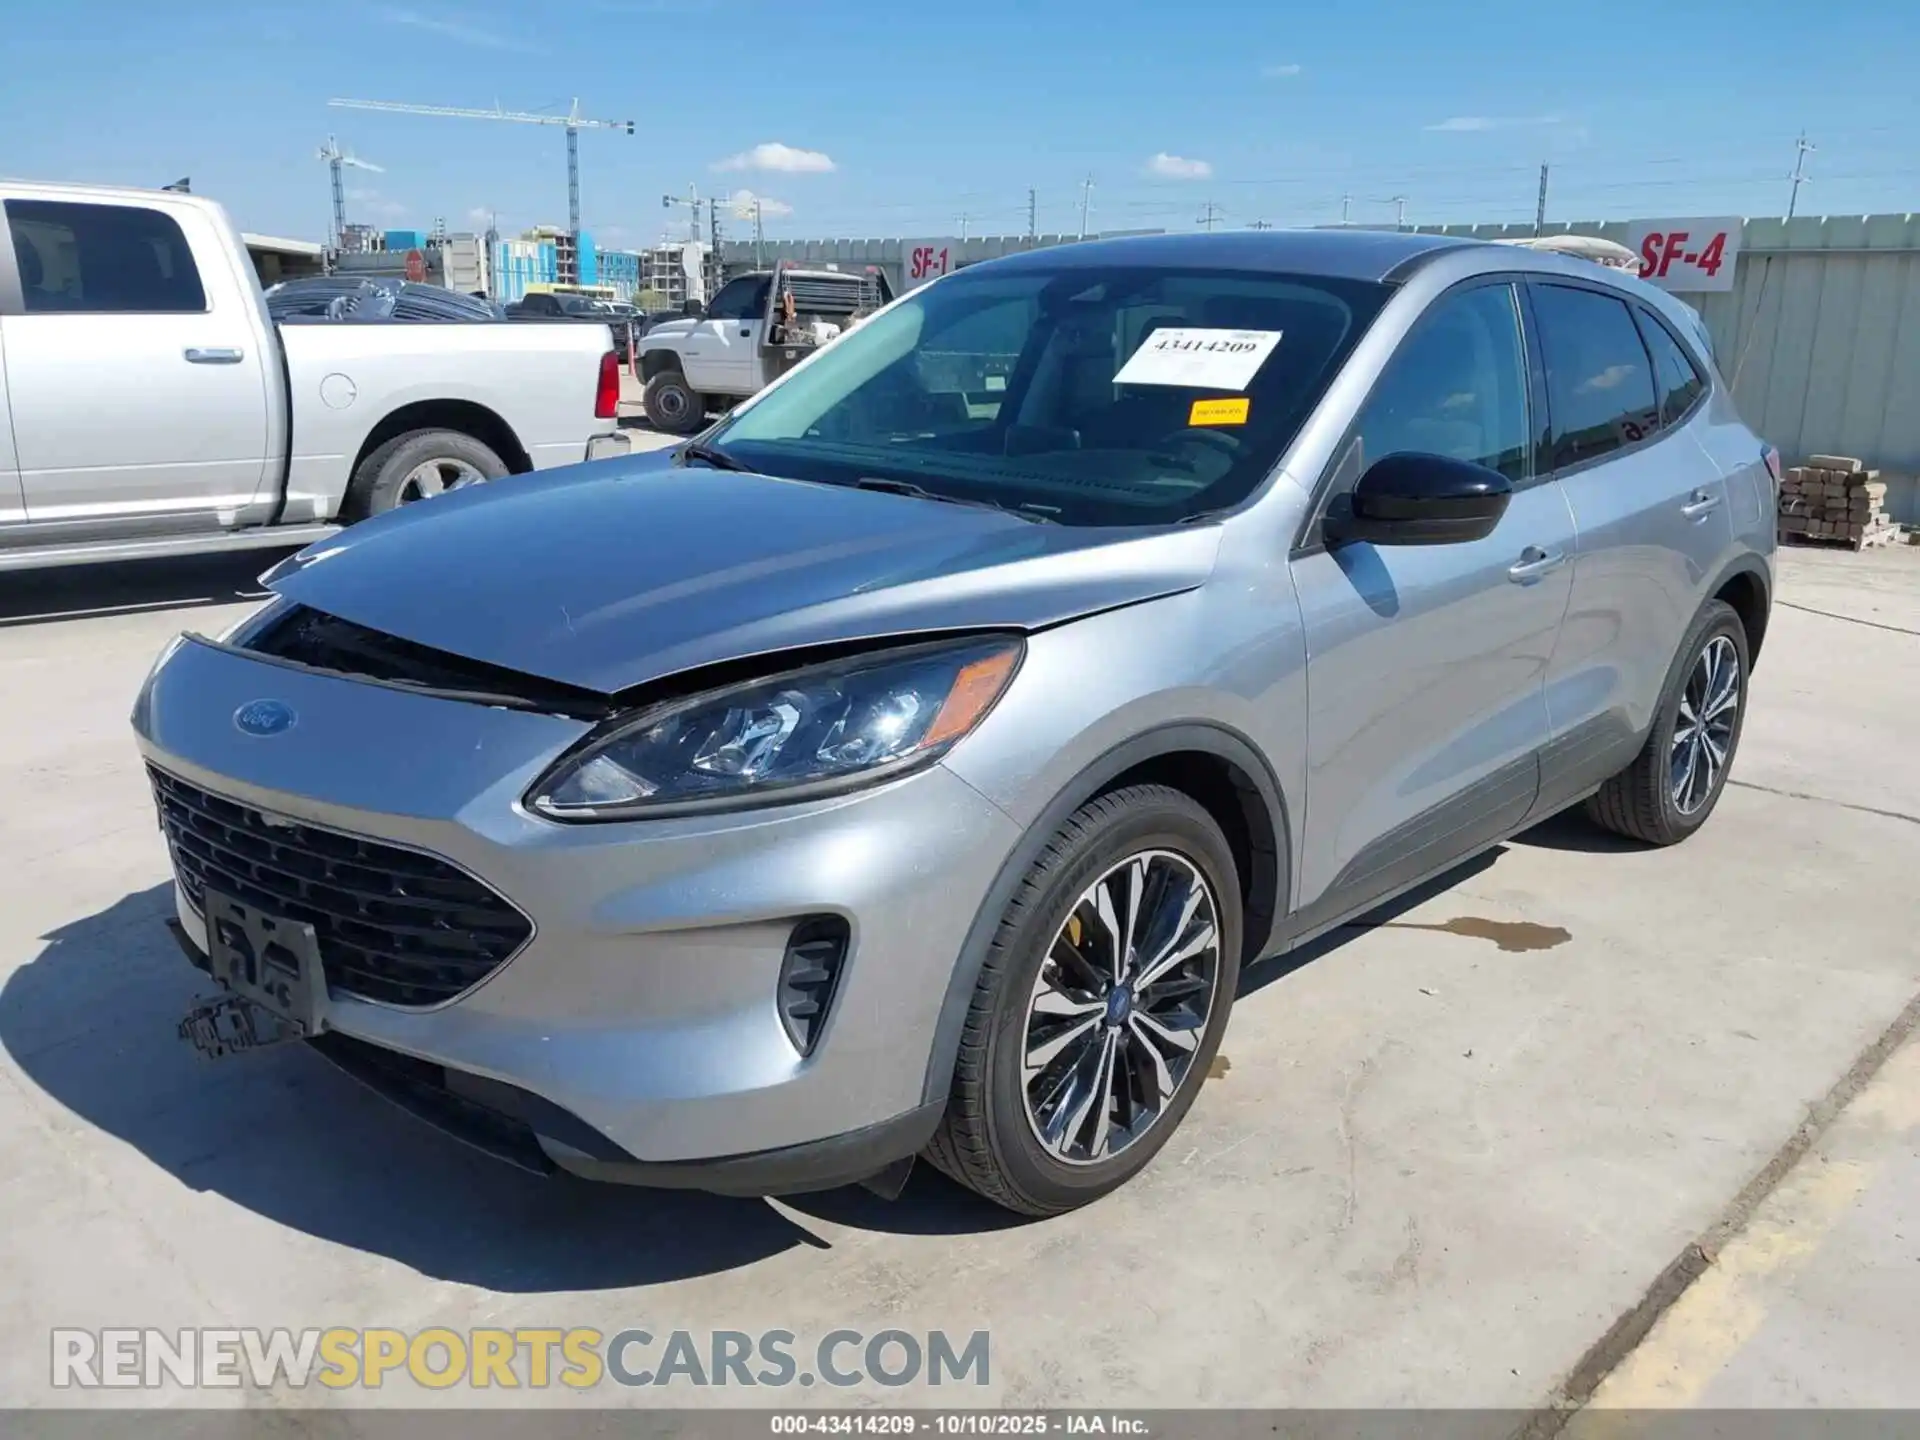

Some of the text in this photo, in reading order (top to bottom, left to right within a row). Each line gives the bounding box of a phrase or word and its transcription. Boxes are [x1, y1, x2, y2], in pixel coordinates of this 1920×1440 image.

[911, 247, 947, 279] SF-1
[1639, 232, 1727, 278] SF-4
[1154, 338, 1257, 354] 43414209
